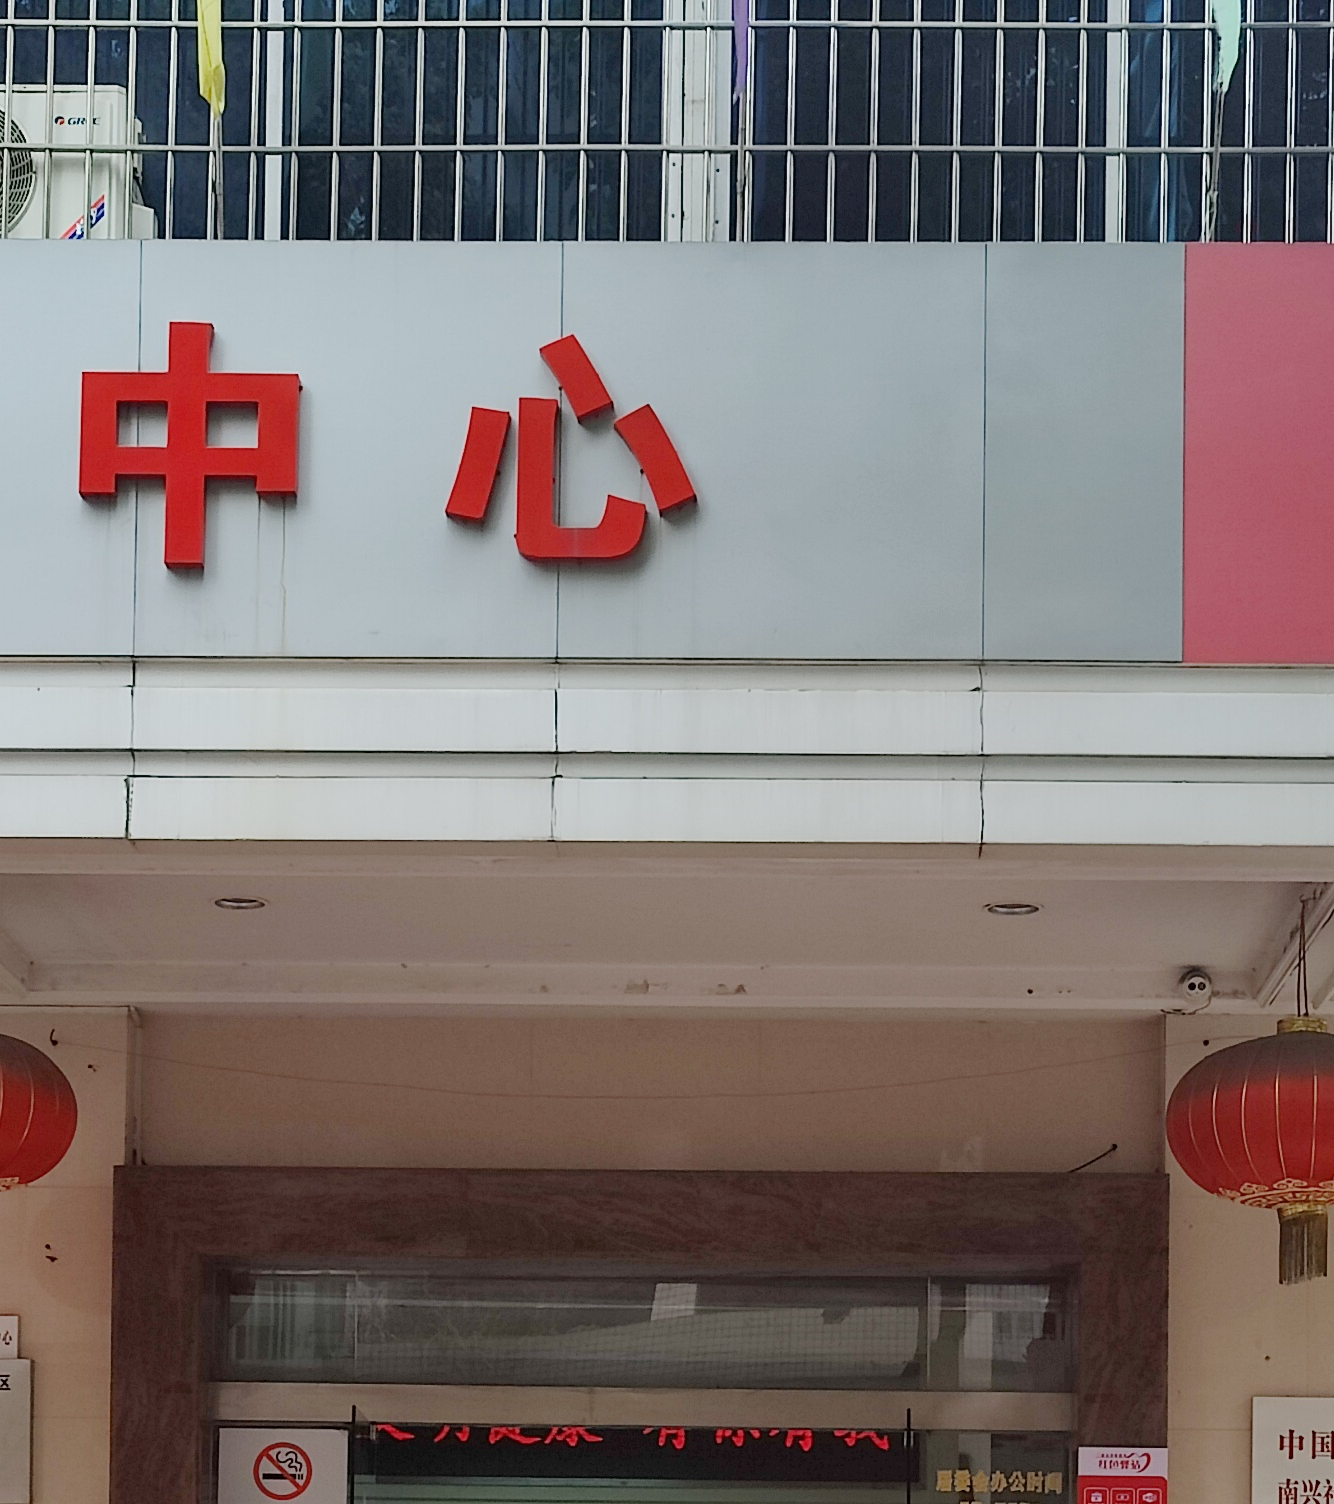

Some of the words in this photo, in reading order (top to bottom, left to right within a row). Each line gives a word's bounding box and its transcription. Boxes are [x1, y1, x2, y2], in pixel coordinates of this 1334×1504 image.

[67, 116, 101, 126] GRE
[936, 1469, 1063, 1494] 居委会办公时间
